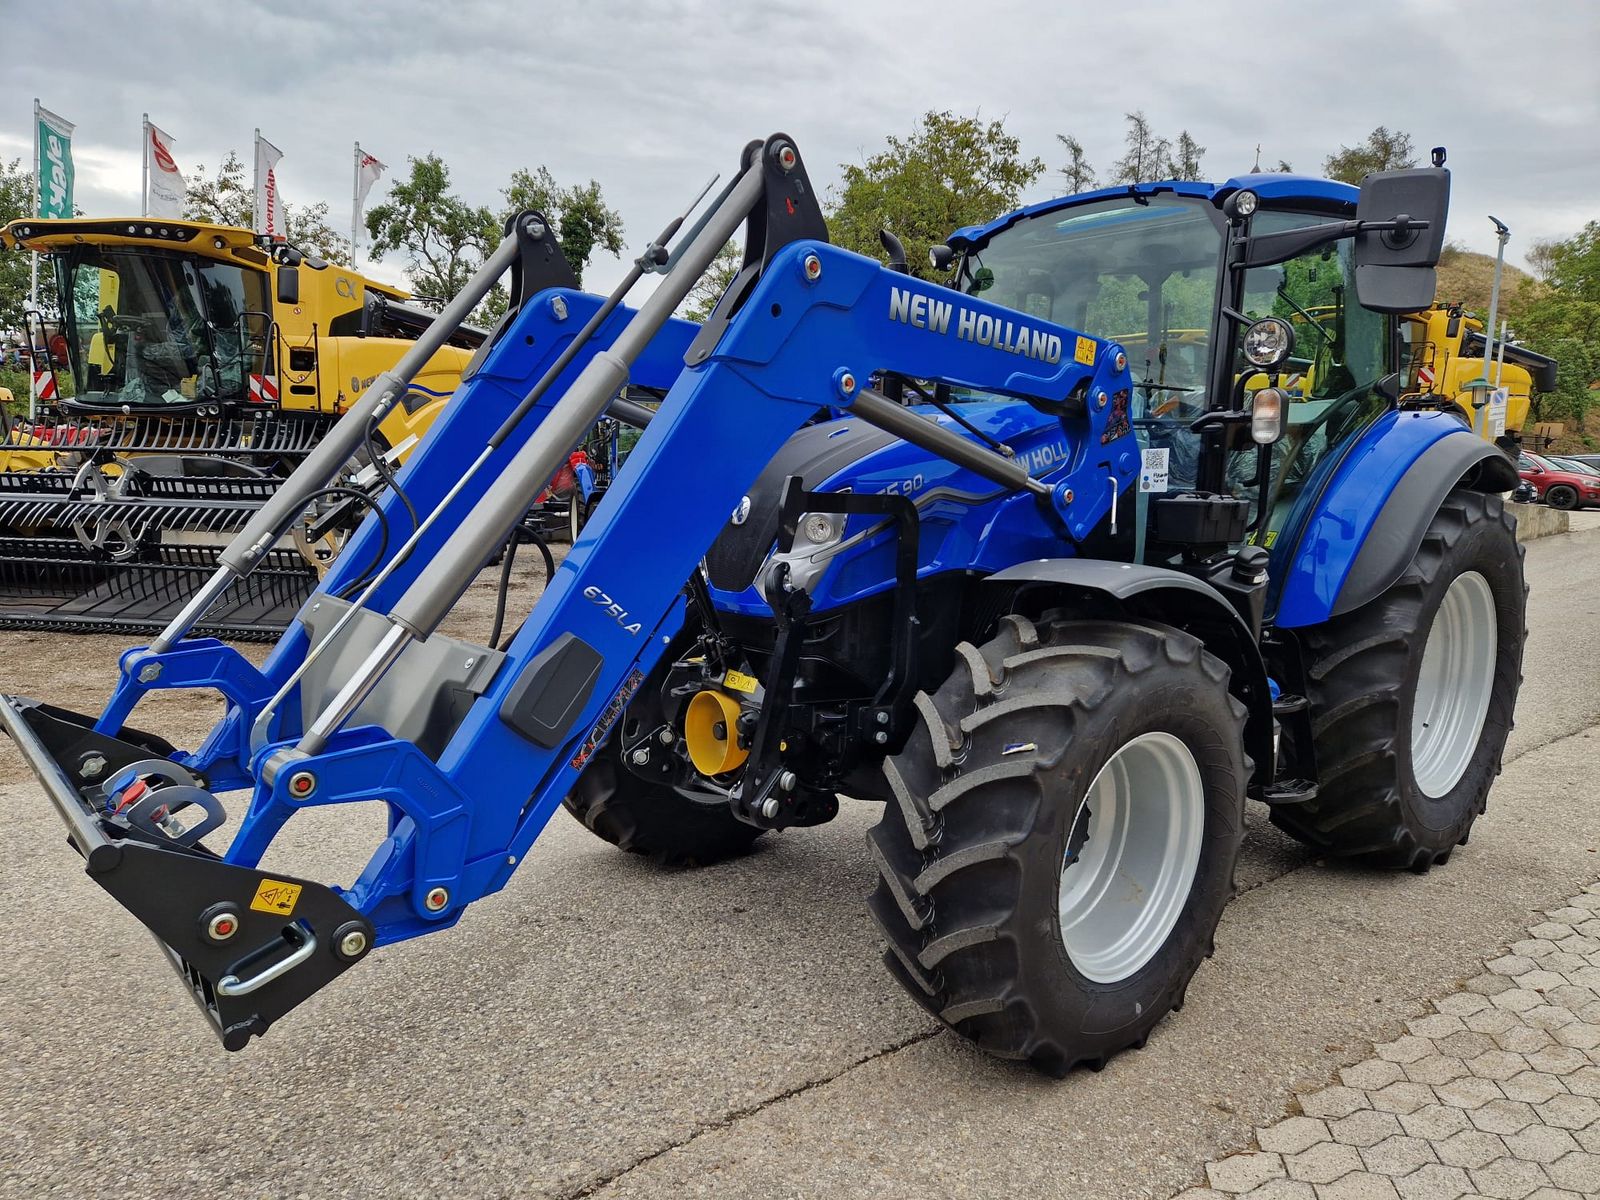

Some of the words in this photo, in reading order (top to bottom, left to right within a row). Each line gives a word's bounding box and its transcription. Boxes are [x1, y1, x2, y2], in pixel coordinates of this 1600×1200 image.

[265, 168, 276, 236] Kvernelan
[335, 276, 358, 301] CX
[888, 285, 953, 335] NEW
[957, 307, 1063, 365] HOLLAND
[1033, 441, 1068, 470] HOLL
[902, 473, 923, 497] 90
[583, 585, 642, 637] 675LA
